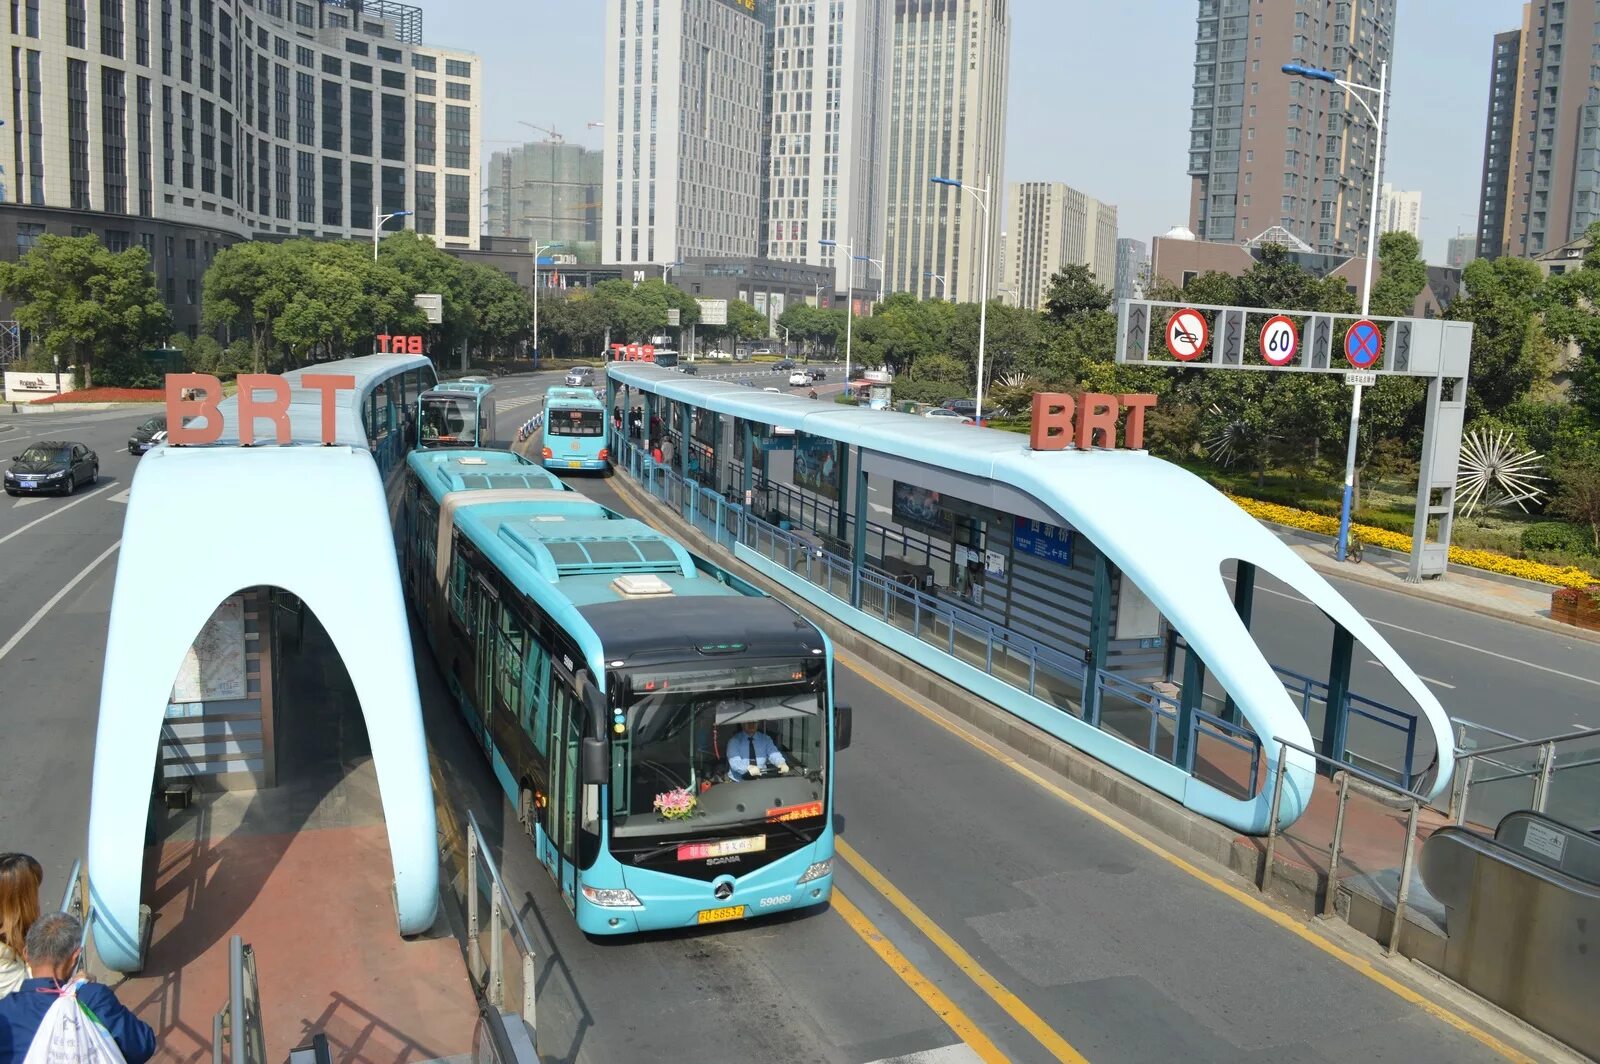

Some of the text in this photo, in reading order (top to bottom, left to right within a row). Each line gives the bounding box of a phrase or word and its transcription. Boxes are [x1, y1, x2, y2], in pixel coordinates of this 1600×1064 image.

[1269, 330, 1290, 352] 60
[165, 373, 356, 445] BRT
[1030, 392, 1158, 451] BRT
[706, 855, 741, 866] SCANIA
[759, 894, 792, 907] 59069
